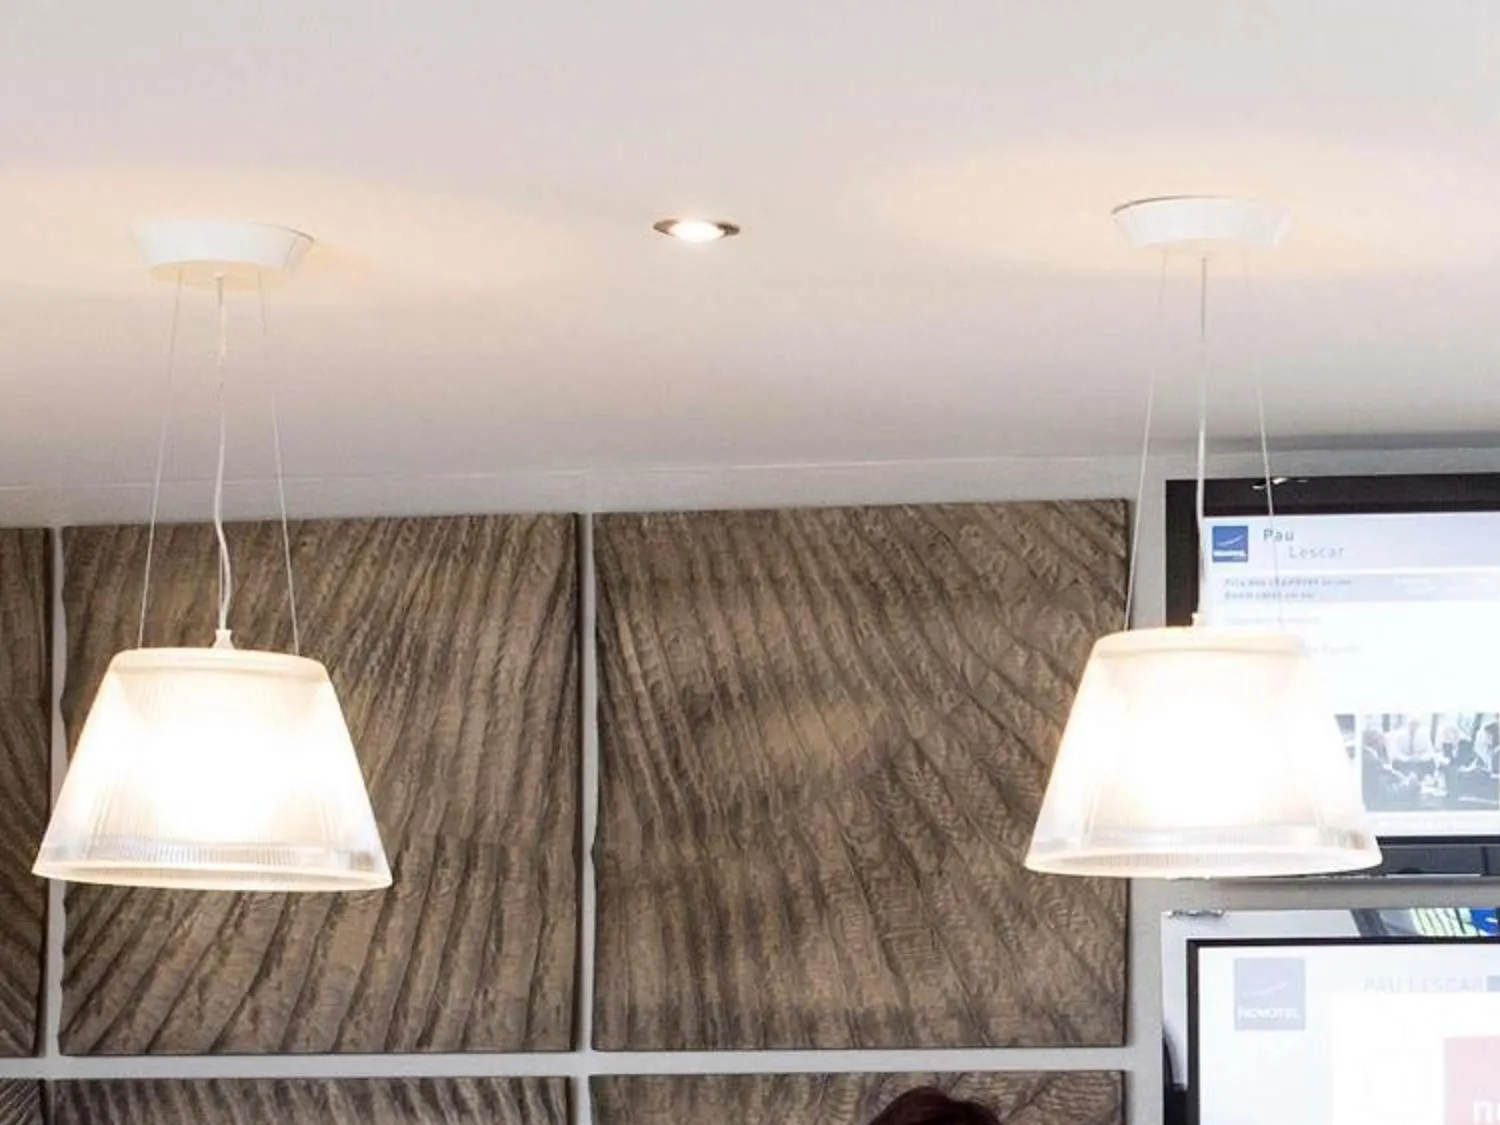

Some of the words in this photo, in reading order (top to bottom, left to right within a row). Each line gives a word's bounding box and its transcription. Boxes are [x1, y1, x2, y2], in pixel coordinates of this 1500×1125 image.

[1263, 528, 1294, 541] Pau
[1289, 545, 1344, 559] Lescar
[1239, 1007, 1300, 1021] NOVOTEL
